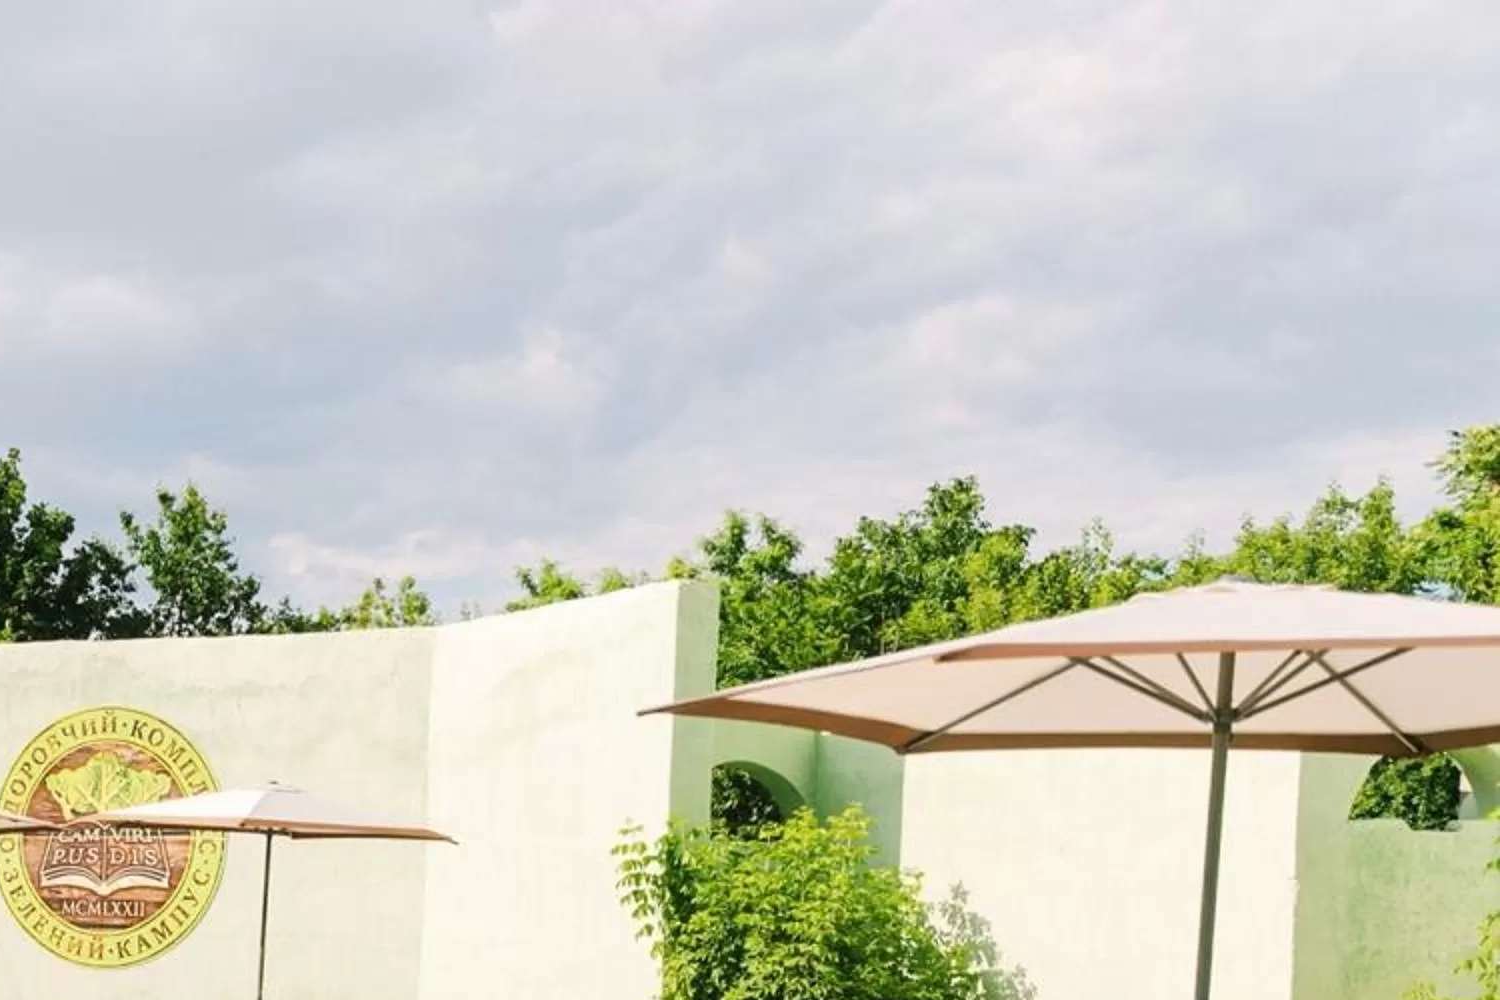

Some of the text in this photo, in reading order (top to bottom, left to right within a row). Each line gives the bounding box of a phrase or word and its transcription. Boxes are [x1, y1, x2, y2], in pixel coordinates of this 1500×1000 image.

[0, 711, 217, 853] ОДОРОВЧИЙ КОМПЛС
[51, 848, 158, 865] PUS DIS
[2, 869, 211, 960] ЗЕЛЕНИЙ КАМПУС
[61, 900, 146, 917] MCMLXXII
